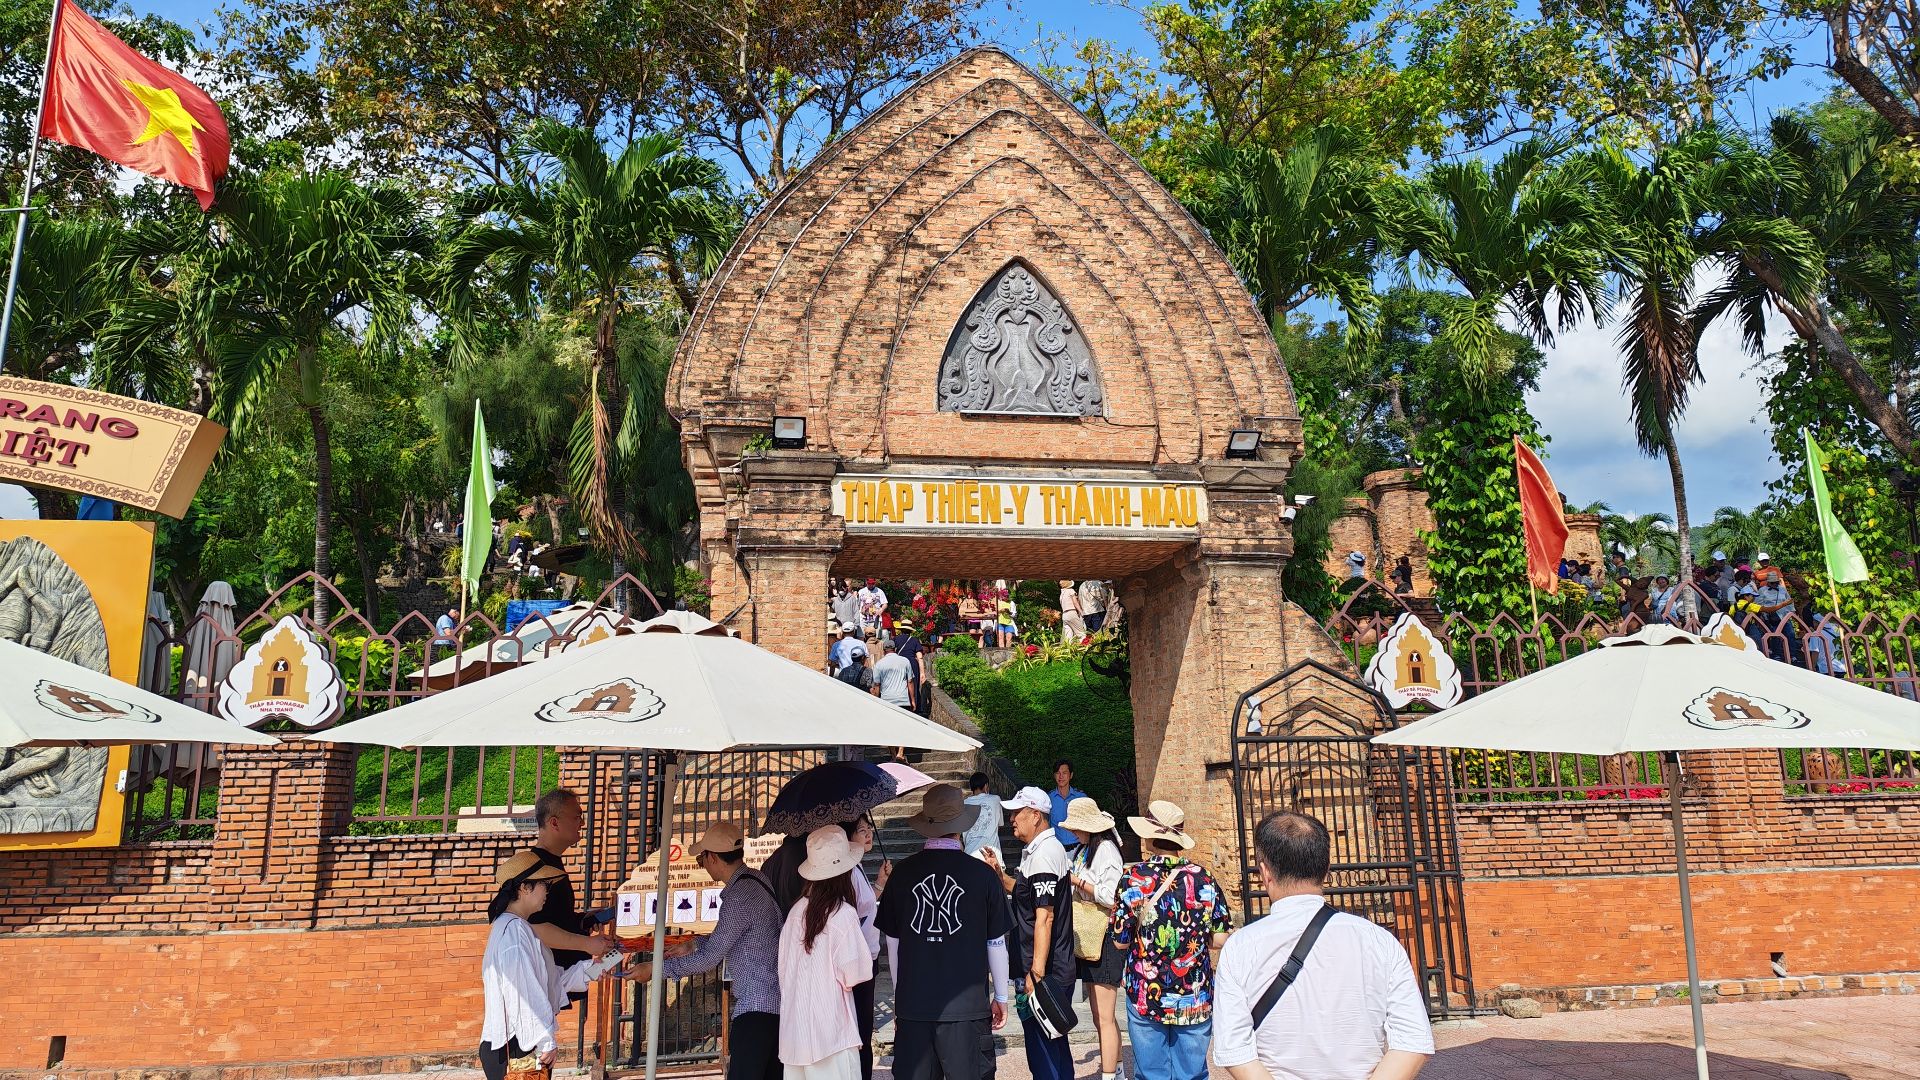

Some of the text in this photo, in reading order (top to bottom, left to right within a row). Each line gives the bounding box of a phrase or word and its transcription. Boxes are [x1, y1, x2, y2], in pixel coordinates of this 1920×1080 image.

[0, 427, 90, 467] IỆT
[841, 478, 914, 523] THÁP
[275, 701, 305, 709] PONAGAR
[910, 873, 965, 935] NY
